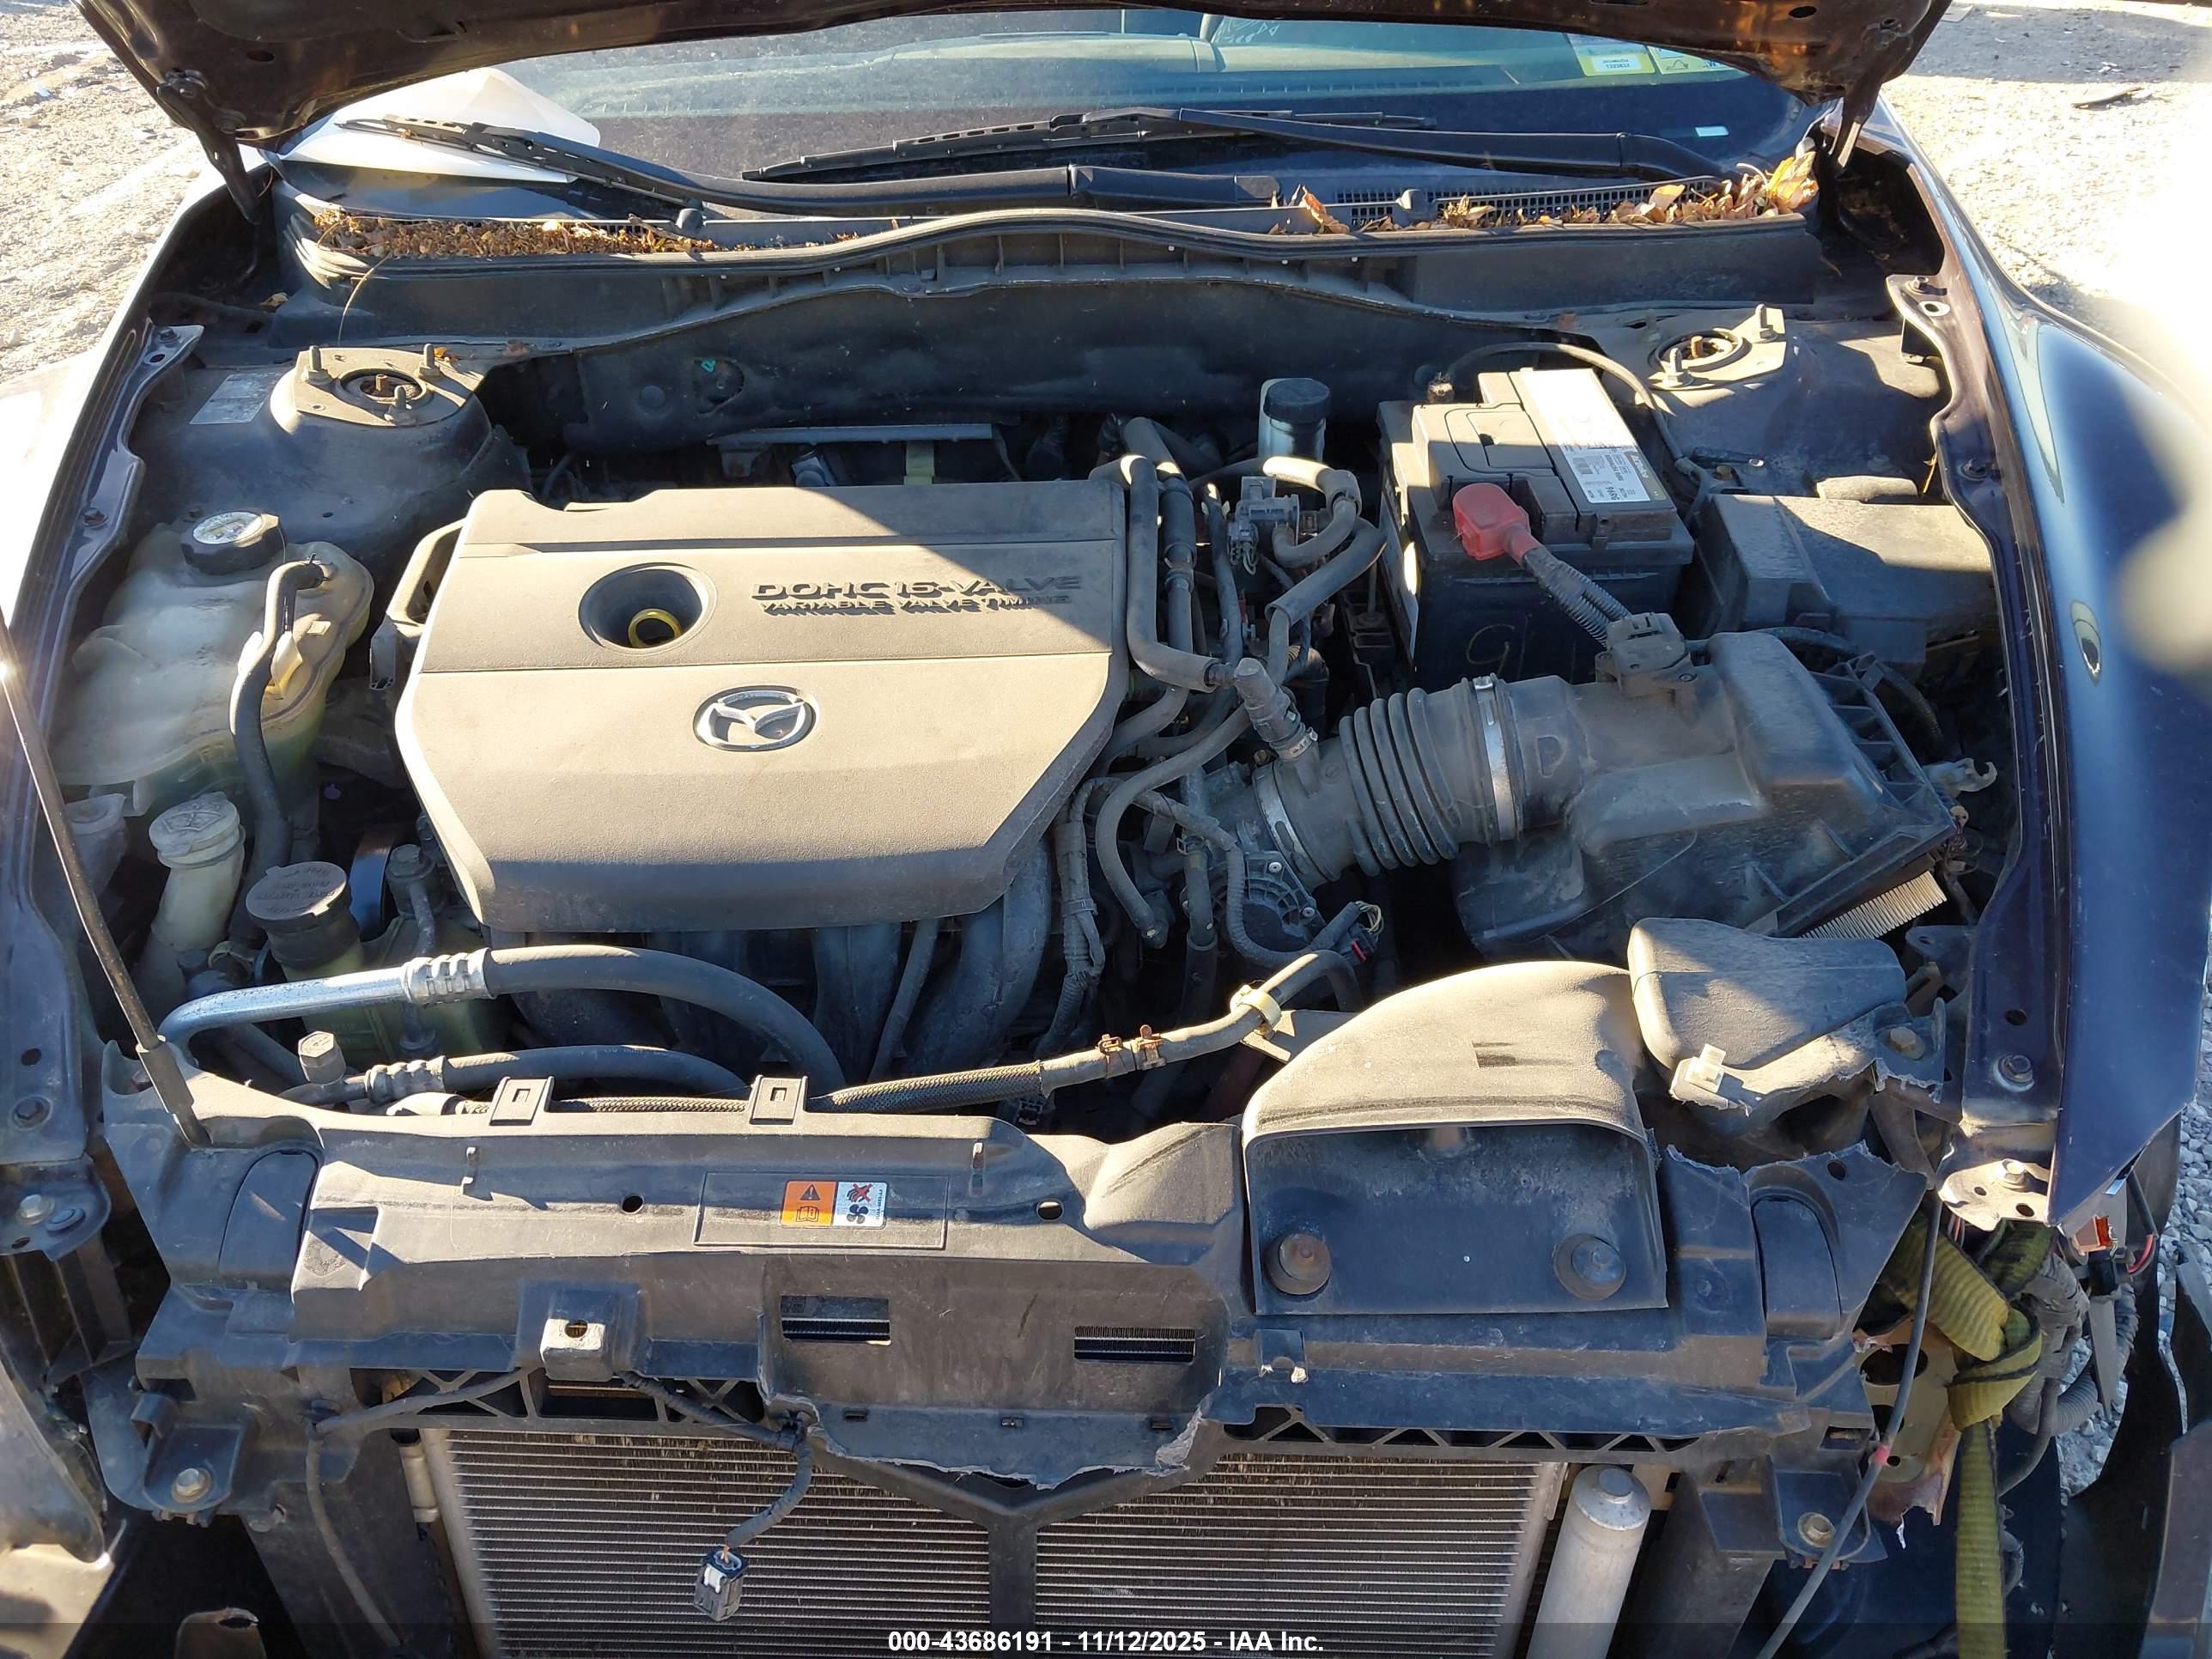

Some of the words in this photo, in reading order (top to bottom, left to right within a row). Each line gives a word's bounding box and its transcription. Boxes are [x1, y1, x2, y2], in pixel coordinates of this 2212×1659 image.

[750, 582, 891, 600] DOHC
[894, 576, 1082, 597] 16-VALVE
[758, 599, 896, 615] VARIABLE
[897, 598, 981, 614] VALVE
[981, 594, 1073, 611] TIMING
